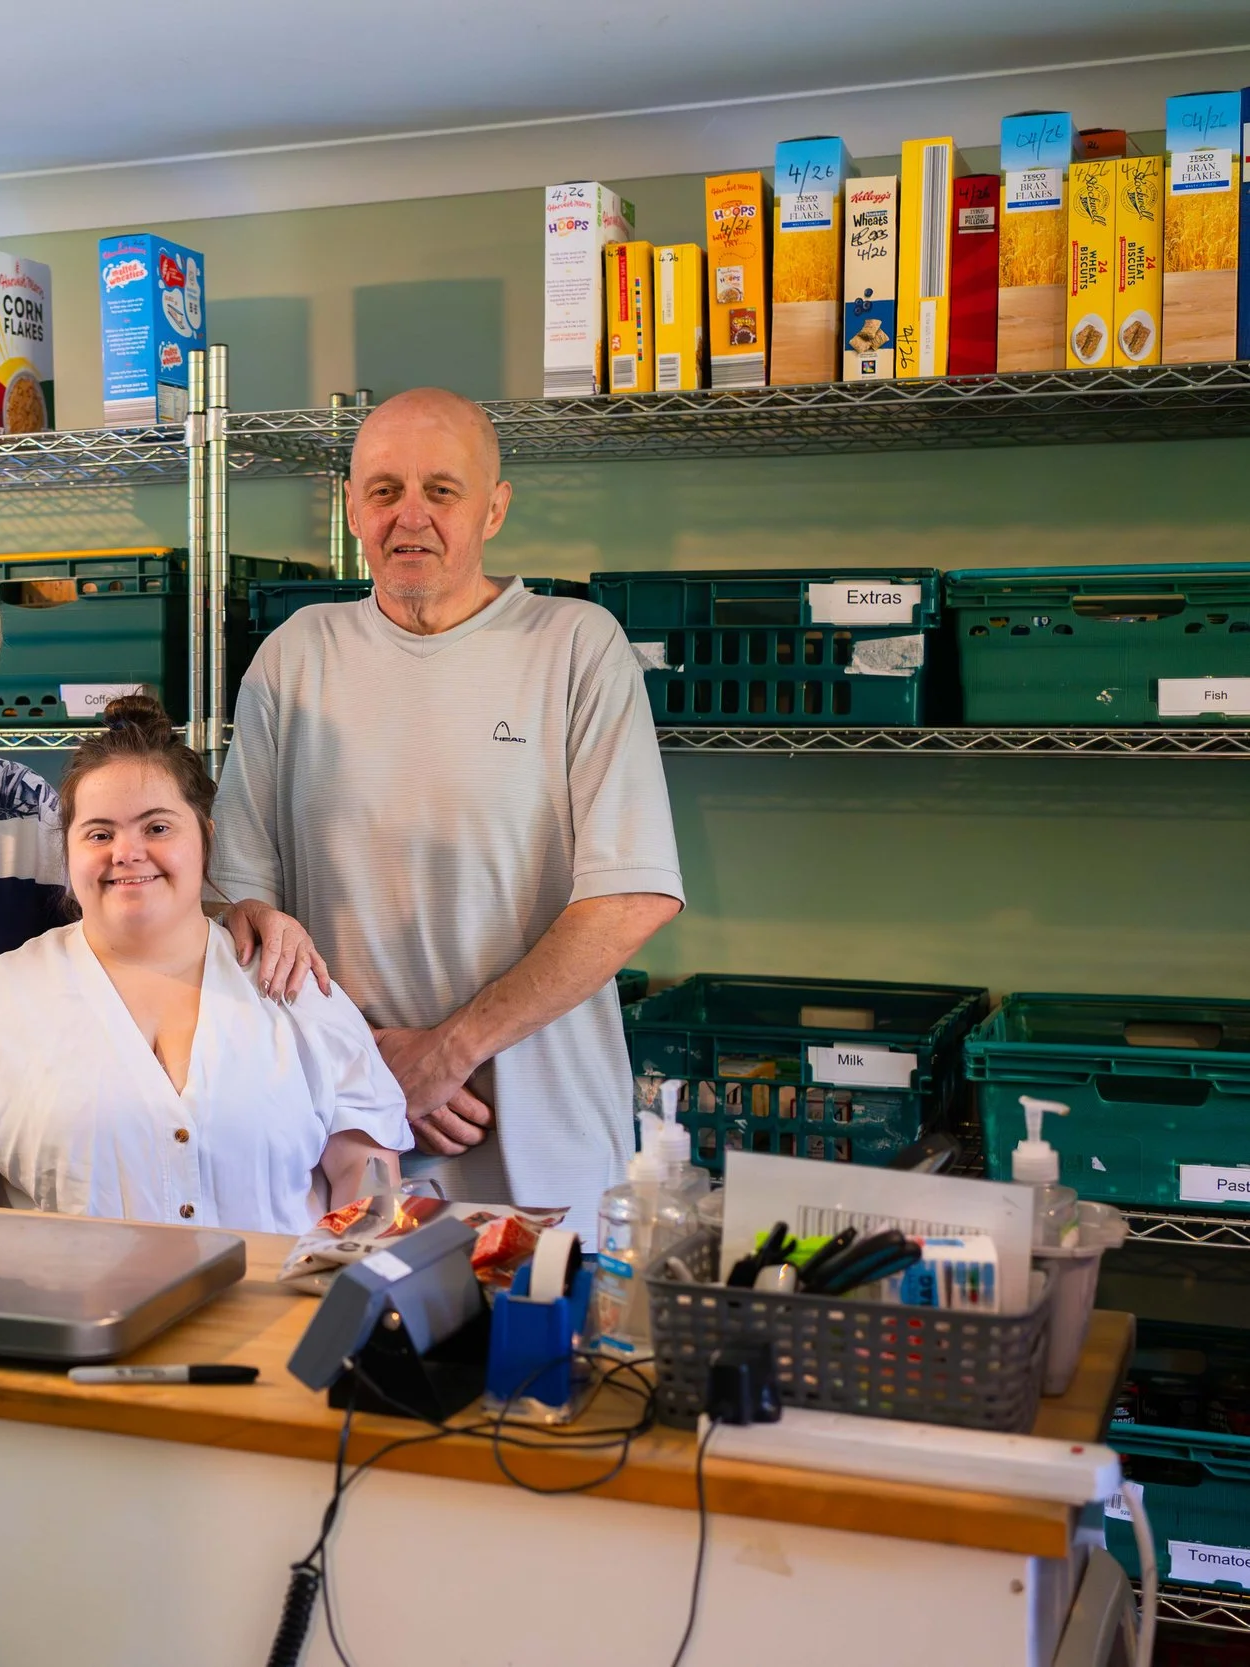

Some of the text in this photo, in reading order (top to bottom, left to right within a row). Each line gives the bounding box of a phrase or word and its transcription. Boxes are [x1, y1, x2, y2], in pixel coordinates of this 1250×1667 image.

[1189, 154, 1214, 162] TESCO
[1187, 162, 1216, 173] BRAN
[789, 160, 834, 196] 4/26
[1023, 173, 1046, 181] TESCO
[1182, 171, 1221, 182] FLAKES
[1020, 182, 1047, 191] BRAN
[851, 190, 891, 203] Kellogg's
[1016, 190, 1052, 200] FLAKES
[1085, 173, 1106, 226] Stockwell
[714, 206, 755, 220] HOOPS
[794, 203, 819, 212] BRAN
[790, 211, 824, 221] FLAKES
[853, 212, 888, 227] Wheats
[548, 220, 589, 233] HOOPS
[721, 214, 752, 239] 4/26
[858, 243, 887, 260] 4/26
[1080, 247, 1088, 290] BISCUITS
[1088, 250, 1097, 284] WHEAT
[1098, 260, 1107, 273] 24
[1128, 242, 1136, 286] BISCUITS
[1136, 246, 1145, 280] WHEAT
[1146, 256, 1156, 270] 24
[3, 295, 43, 323] CORN
[4, 318, 43, 341] FLAKES
[847, 589, 902, 604] Extras
[85, 694, 116, 704] Coffe
[1204, 690, 1228, 700] Fish
[838, 1054, 864, 1066] Milk
